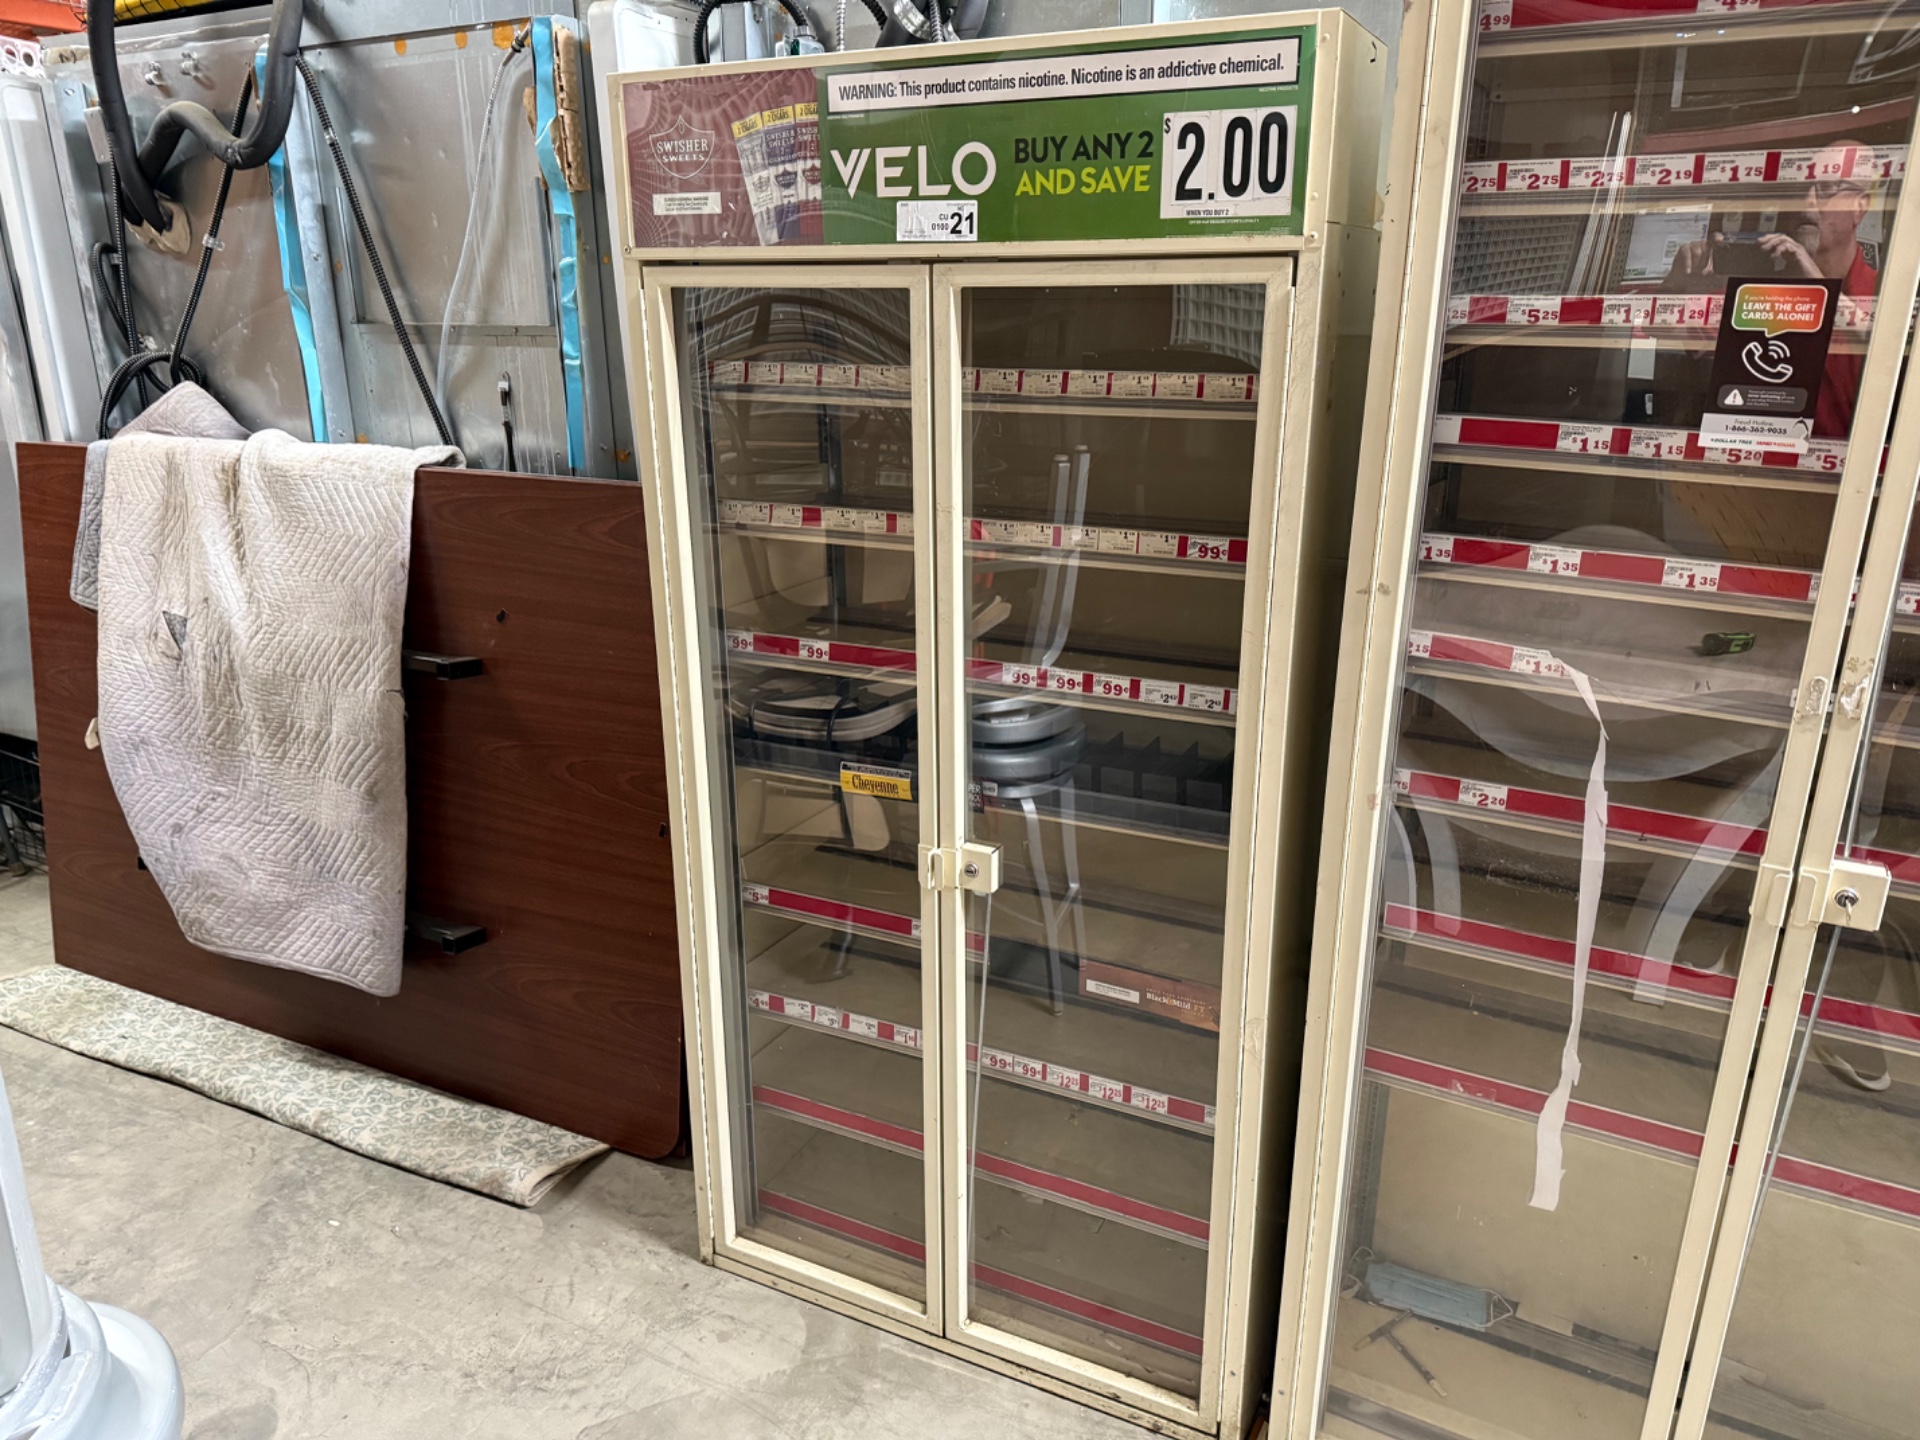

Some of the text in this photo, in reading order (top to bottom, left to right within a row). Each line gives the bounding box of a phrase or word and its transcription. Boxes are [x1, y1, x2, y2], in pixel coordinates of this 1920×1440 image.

[839, 52, 1285, 101] WARNING: This product contains nicotine. Nicotine is an addictive chemical.
[656, 137, 709, 152] SWISHER
[1013, 129, 1155, 164] BUY ANY 2
[662, 153, 705, 164] SWEETS
[830, 140, 998, 200] VELO
[1014, 164, 1151, 197] AND SAVE
[938, 213, 949, 221] CU
[949, 211, 974, 235] 21
[1741, 311, 1815, 322] CARDS ALONE!
[1742, 302, 1817, 312] LEAVE THE GIFT
[851, 773, 899, 794] Cheyenne
